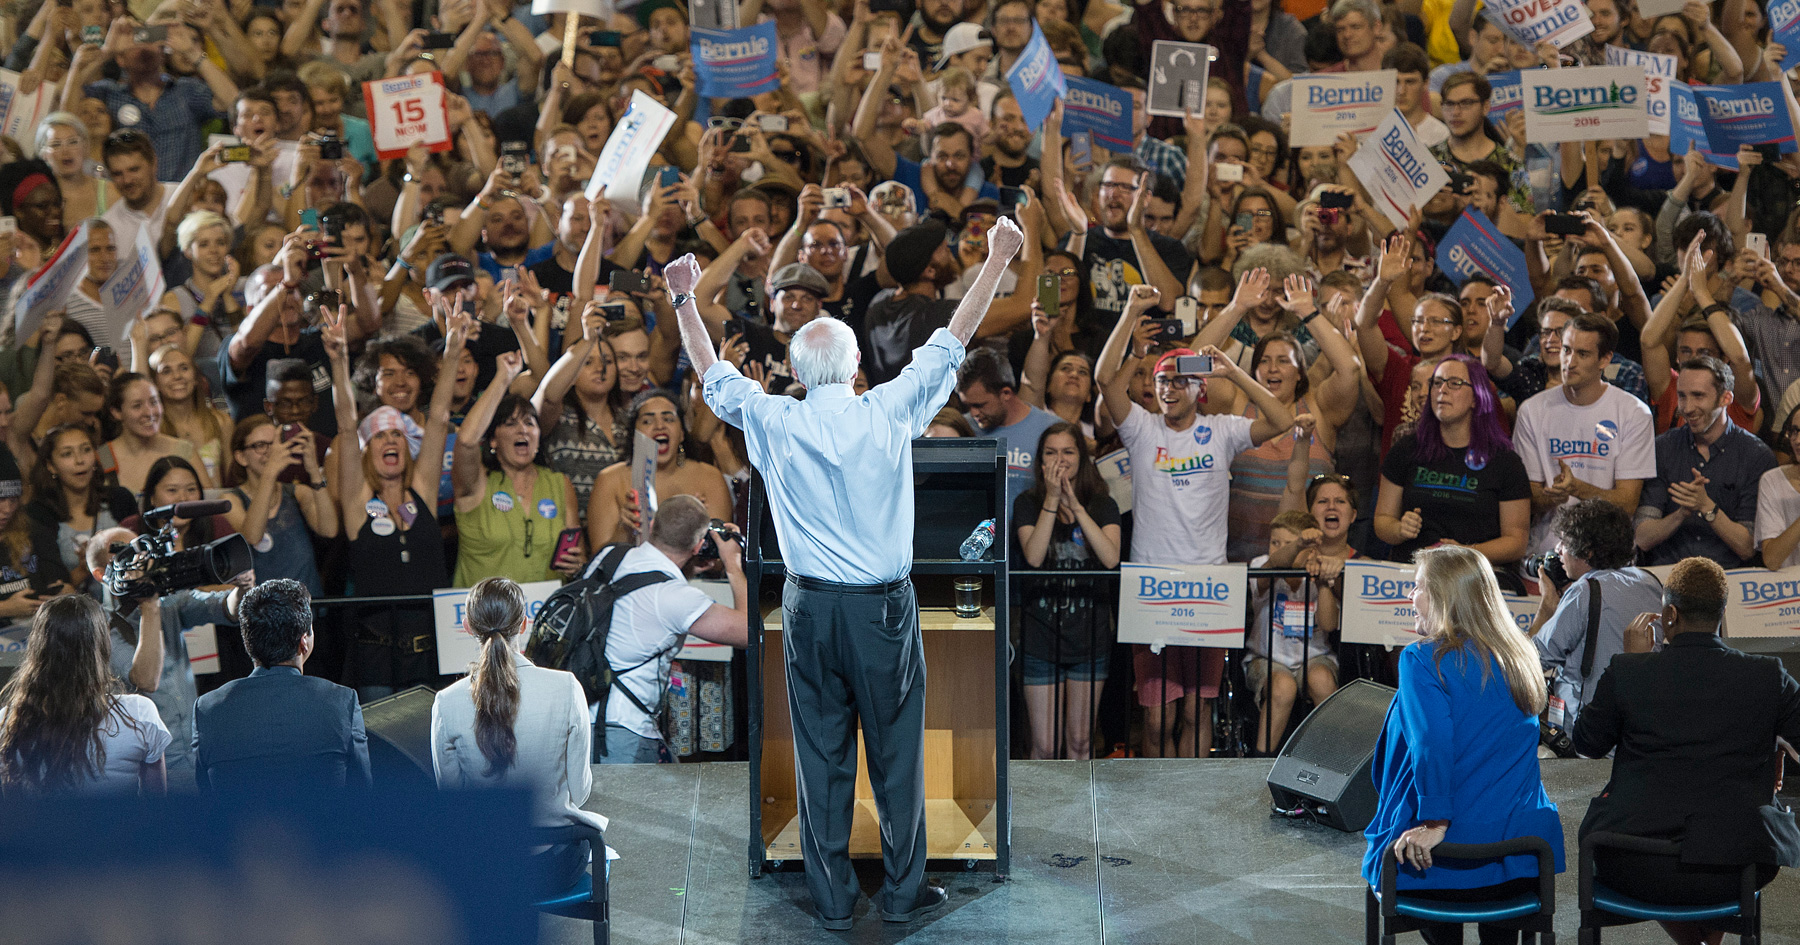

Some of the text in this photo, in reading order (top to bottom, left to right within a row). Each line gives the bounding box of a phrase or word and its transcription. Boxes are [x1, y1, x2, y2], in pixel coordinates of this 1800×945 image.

[699, 35, 769, 61] Bernie
[382, 78, 424, 94] Bernie
[1308, 81, 1384, 106] Bernie
[1533, 79, 1638, 108] Bernie
[390, 98, 425, 124] 15
[1064, 87, 1123, 117] ernie
[1705, 93, 1775, 118] Bernie
[1336, 112, 1357, 121] 2016
[1574, 116, 1601, 128] 2016
[396, 123, 427, 137] NOW
[1383, 125, 1429, 189] Bernie
[1549, 438, 1610, 457] Bernie
[1415, 466, 1479, 490] Bernie
[1432, 490, 1450, 499] 2016
[1138, 576, 1229, 601] Bernie
[1361, 574, 1417, 599] Ber
[1171, 607, 1195, 617] 2016
